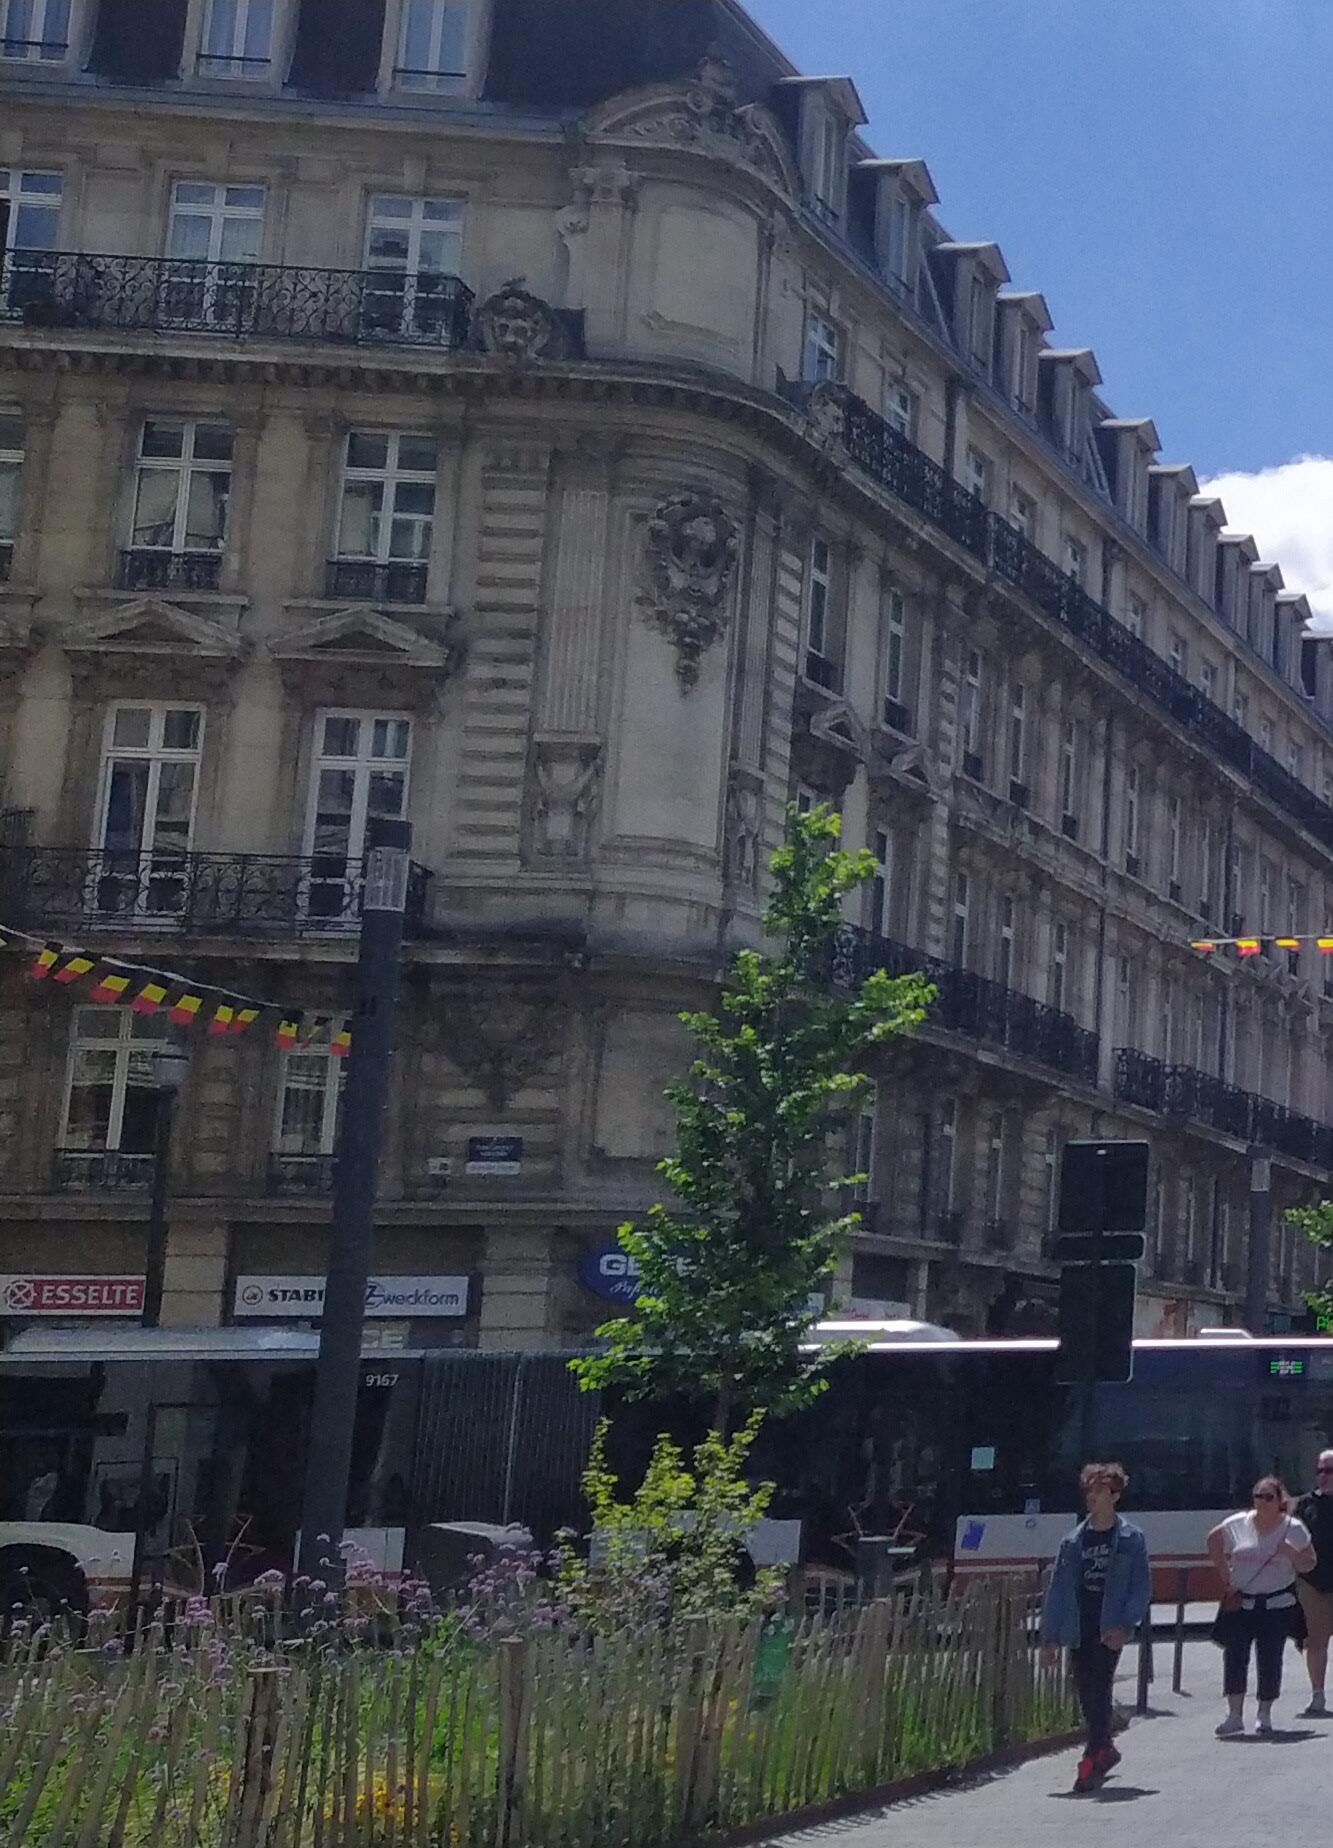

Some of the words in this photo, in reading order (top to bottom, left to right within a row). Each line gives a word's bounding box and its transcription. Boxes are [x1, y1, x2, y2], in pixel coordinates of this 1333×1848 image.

[41, 1285, 139, 1305] ESSELTE
[268, 1288, 325, 1302] STABI
[366, 1374, 399, 1386] 9167
